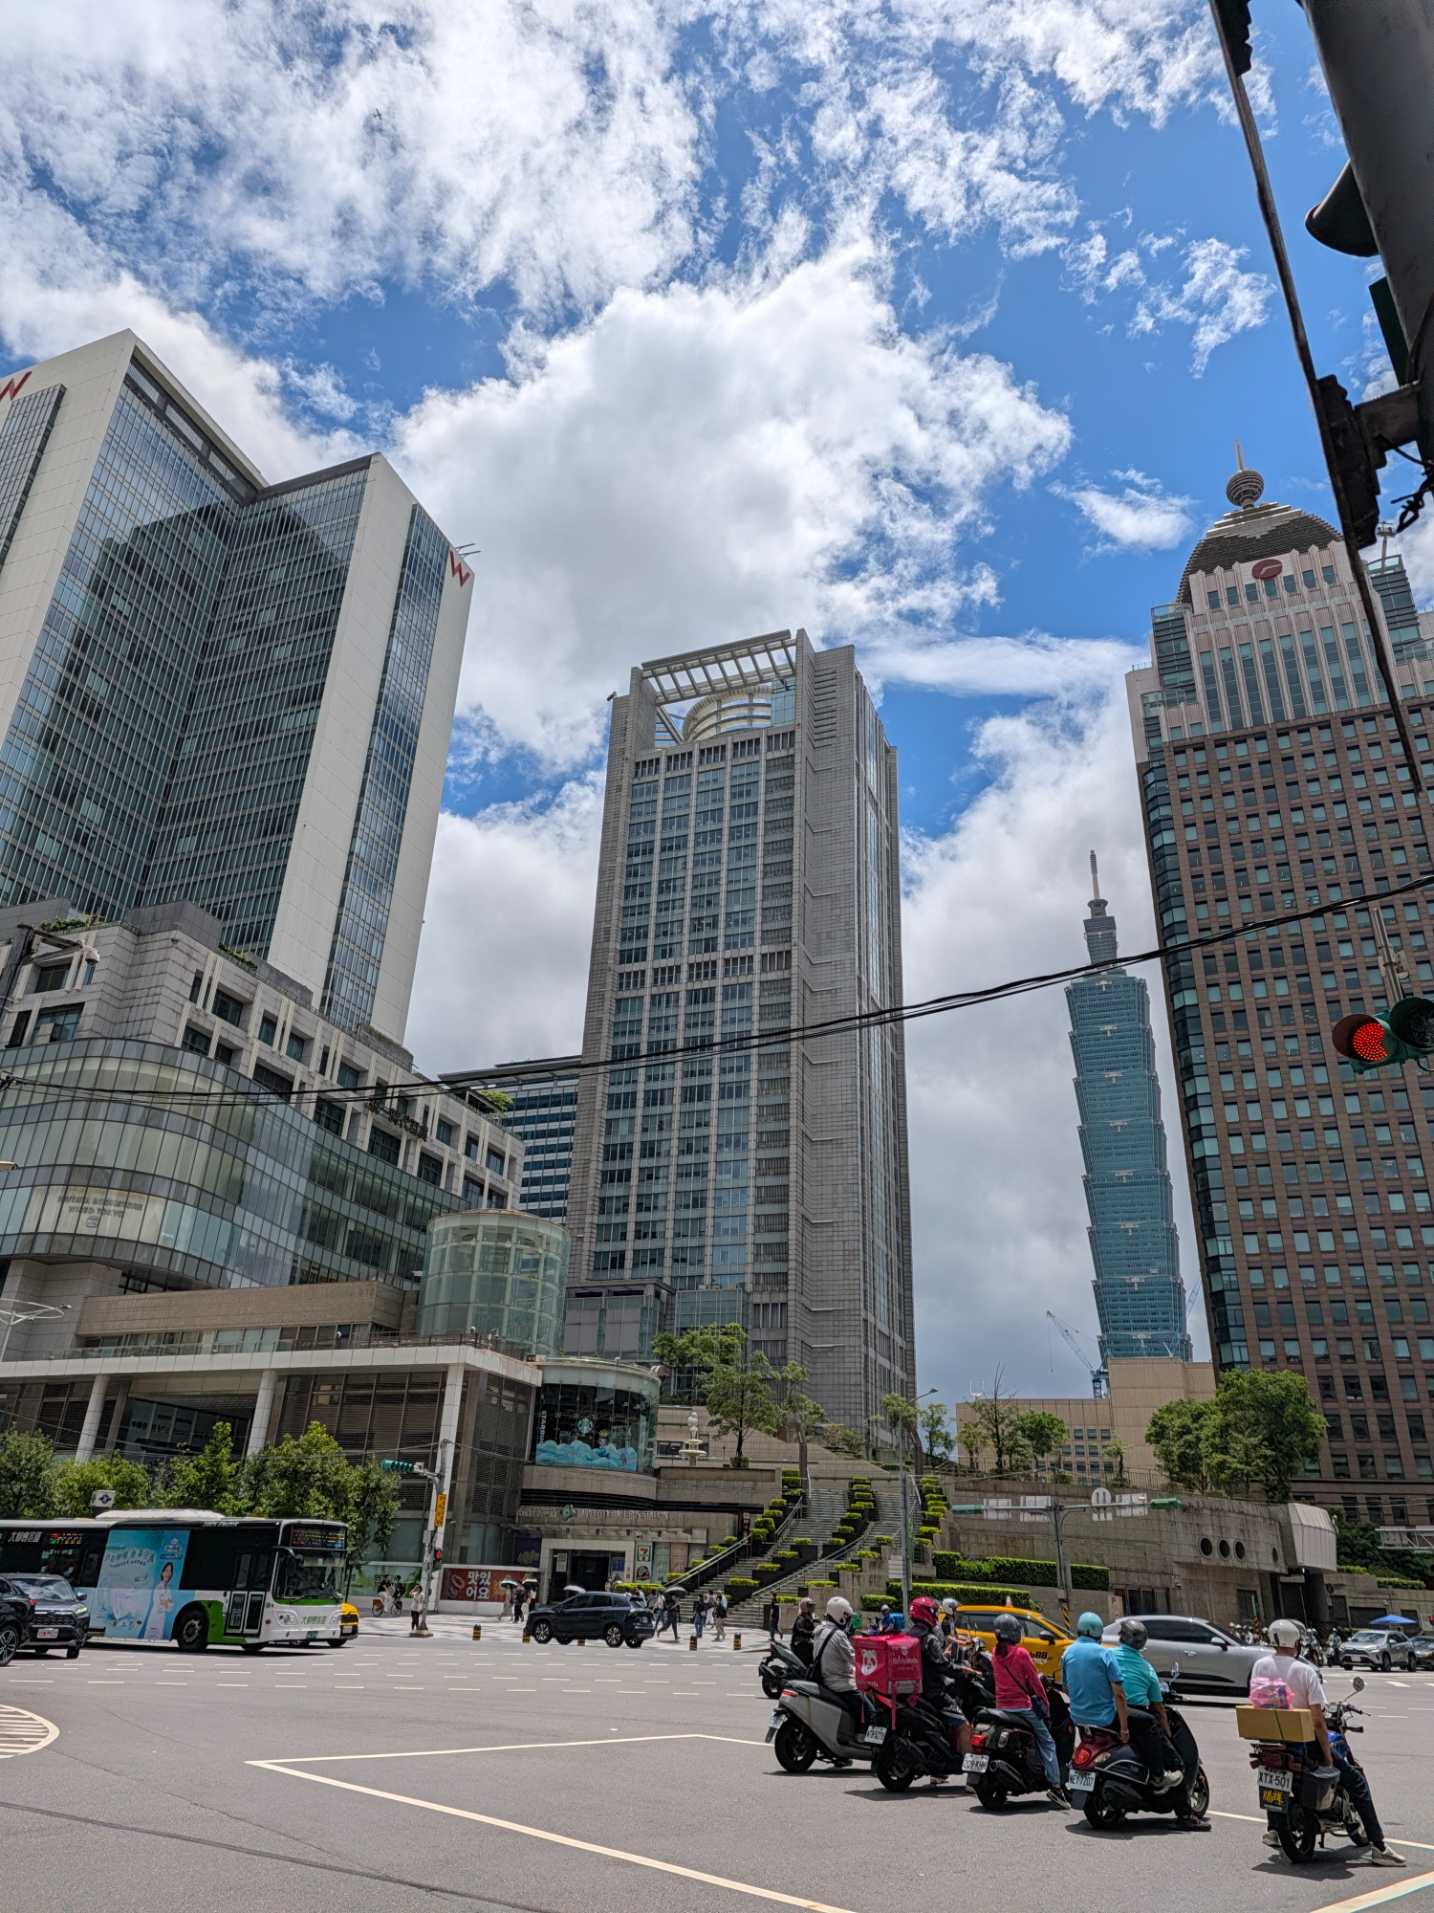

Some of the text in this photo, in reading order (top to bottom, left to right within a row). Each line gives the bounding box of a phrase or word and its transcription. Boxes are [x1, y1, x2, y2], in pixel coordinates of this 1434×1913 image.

[449, 550, 471, 588] W
[467, 1571, 491, 1585] 맛있
[466, 1585, 490, 1600] 어요
